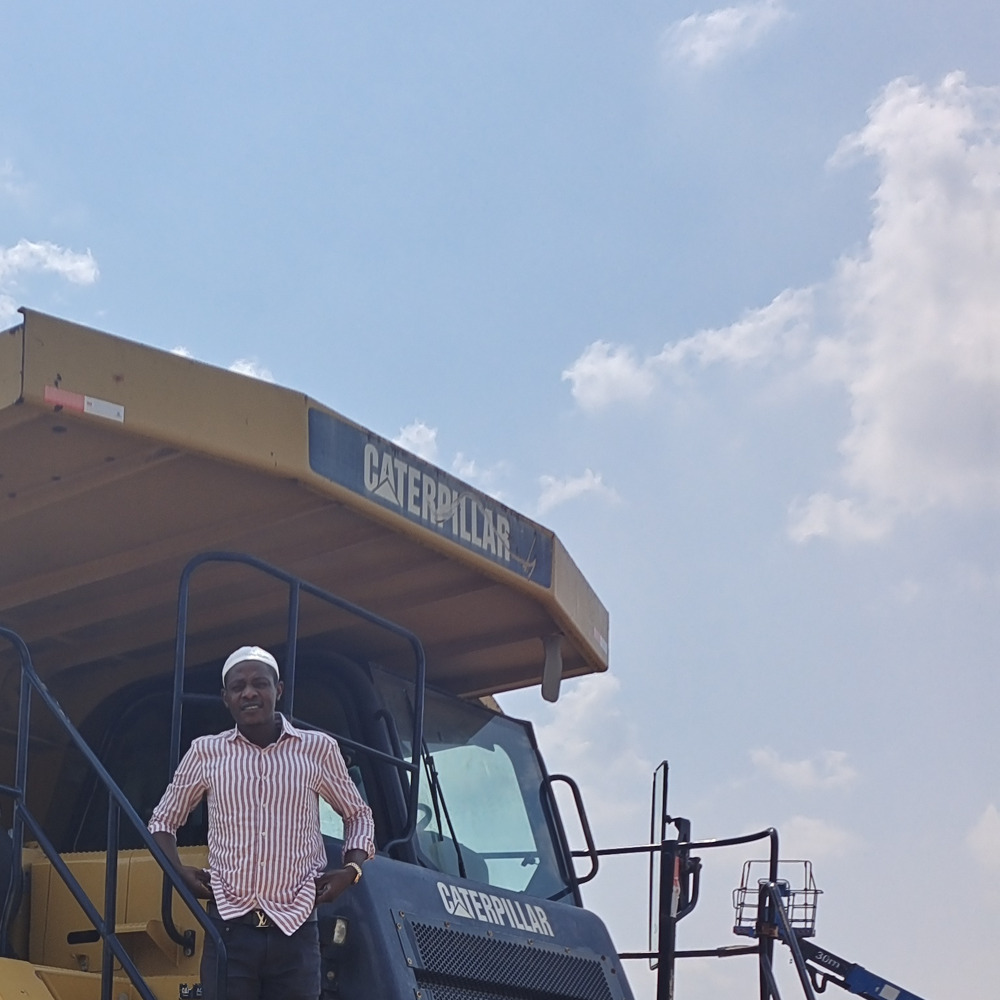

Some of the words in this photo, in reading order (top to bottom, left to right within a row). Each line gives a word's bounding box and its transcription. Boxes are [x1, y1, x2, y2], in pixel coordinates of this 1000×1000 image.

[364, 443, 511, 562] CATERPILLAR
[436, 881, 555, 938] CATERPILLAR
[815, 951, 841, 968] 30m
